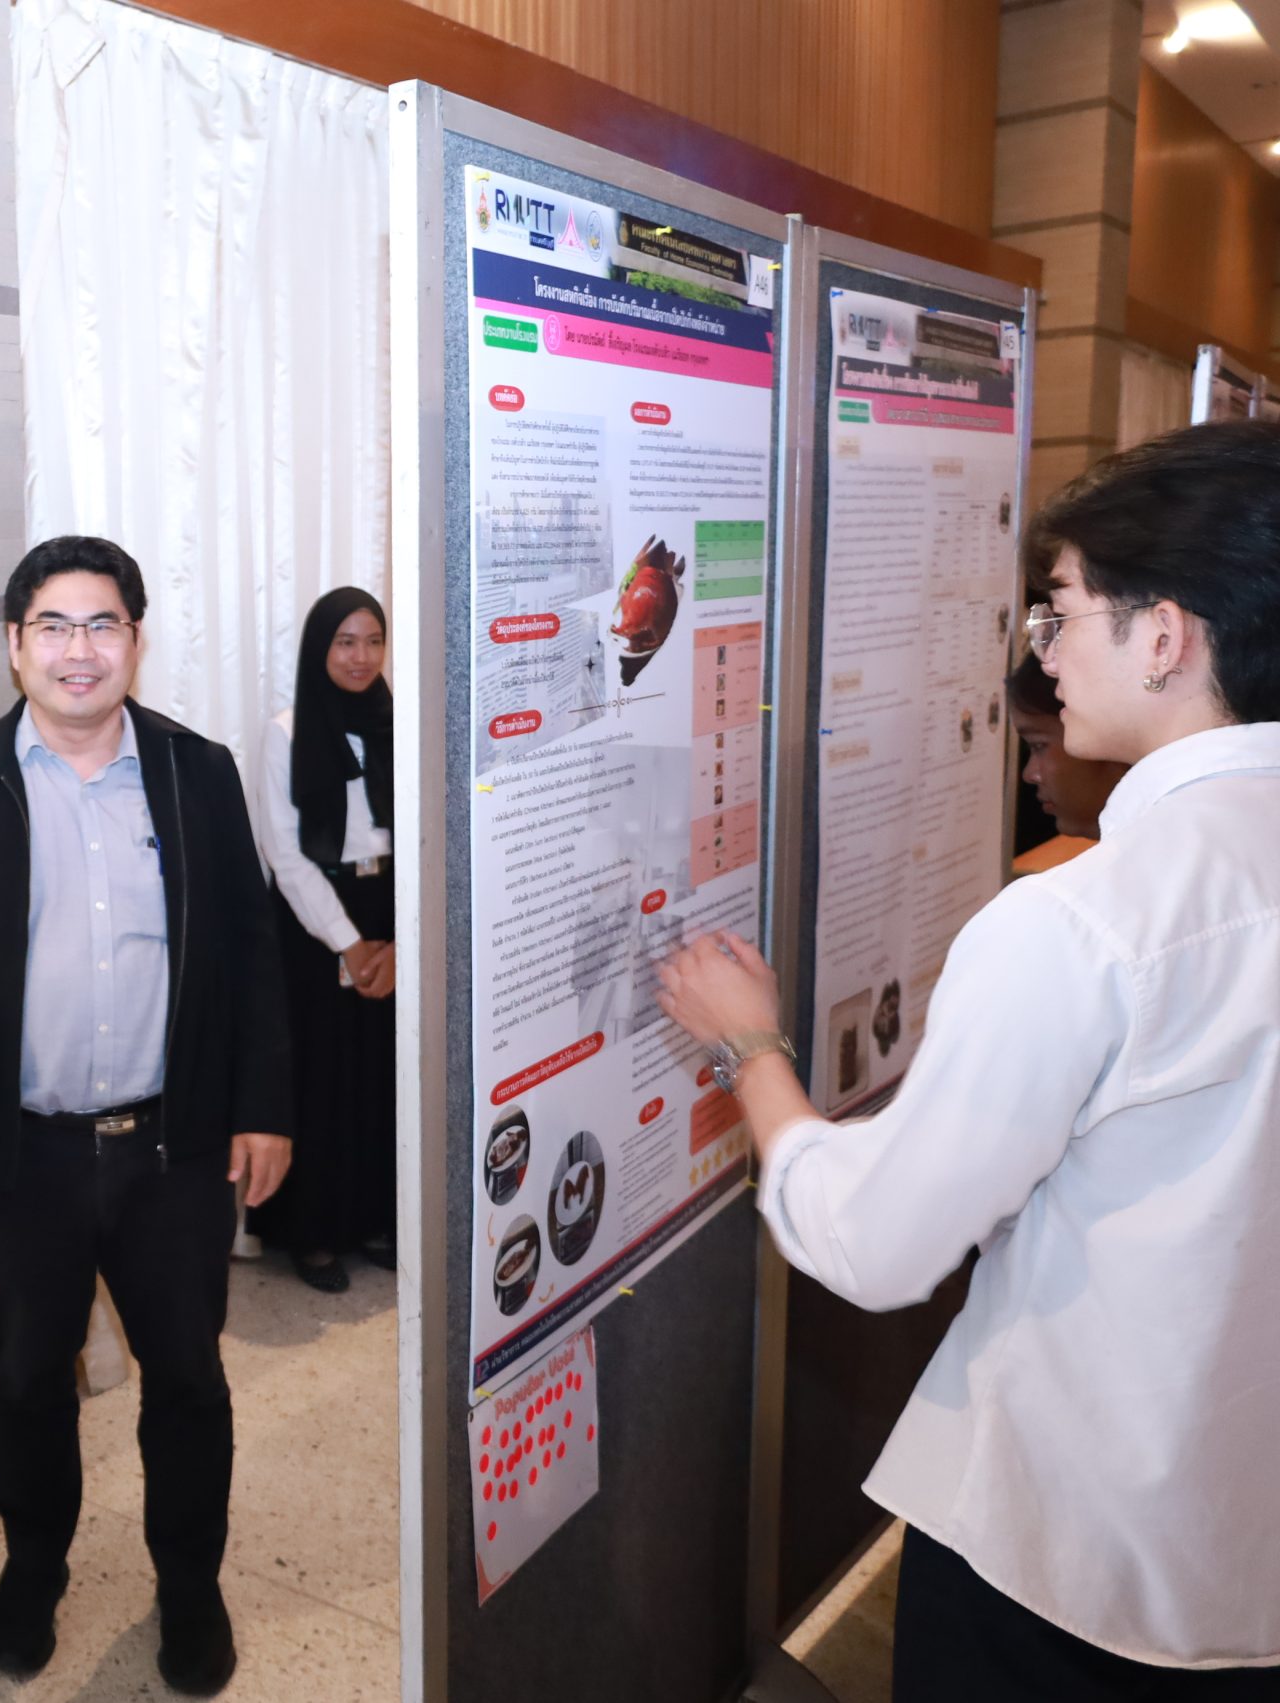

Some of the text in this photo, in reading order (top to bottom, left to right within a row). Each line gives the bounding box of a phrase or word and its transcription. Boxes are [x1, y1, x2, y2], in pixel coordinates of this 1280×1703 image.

[533, 275, 598, 309] โครงงานสหกิจเรื่อง
